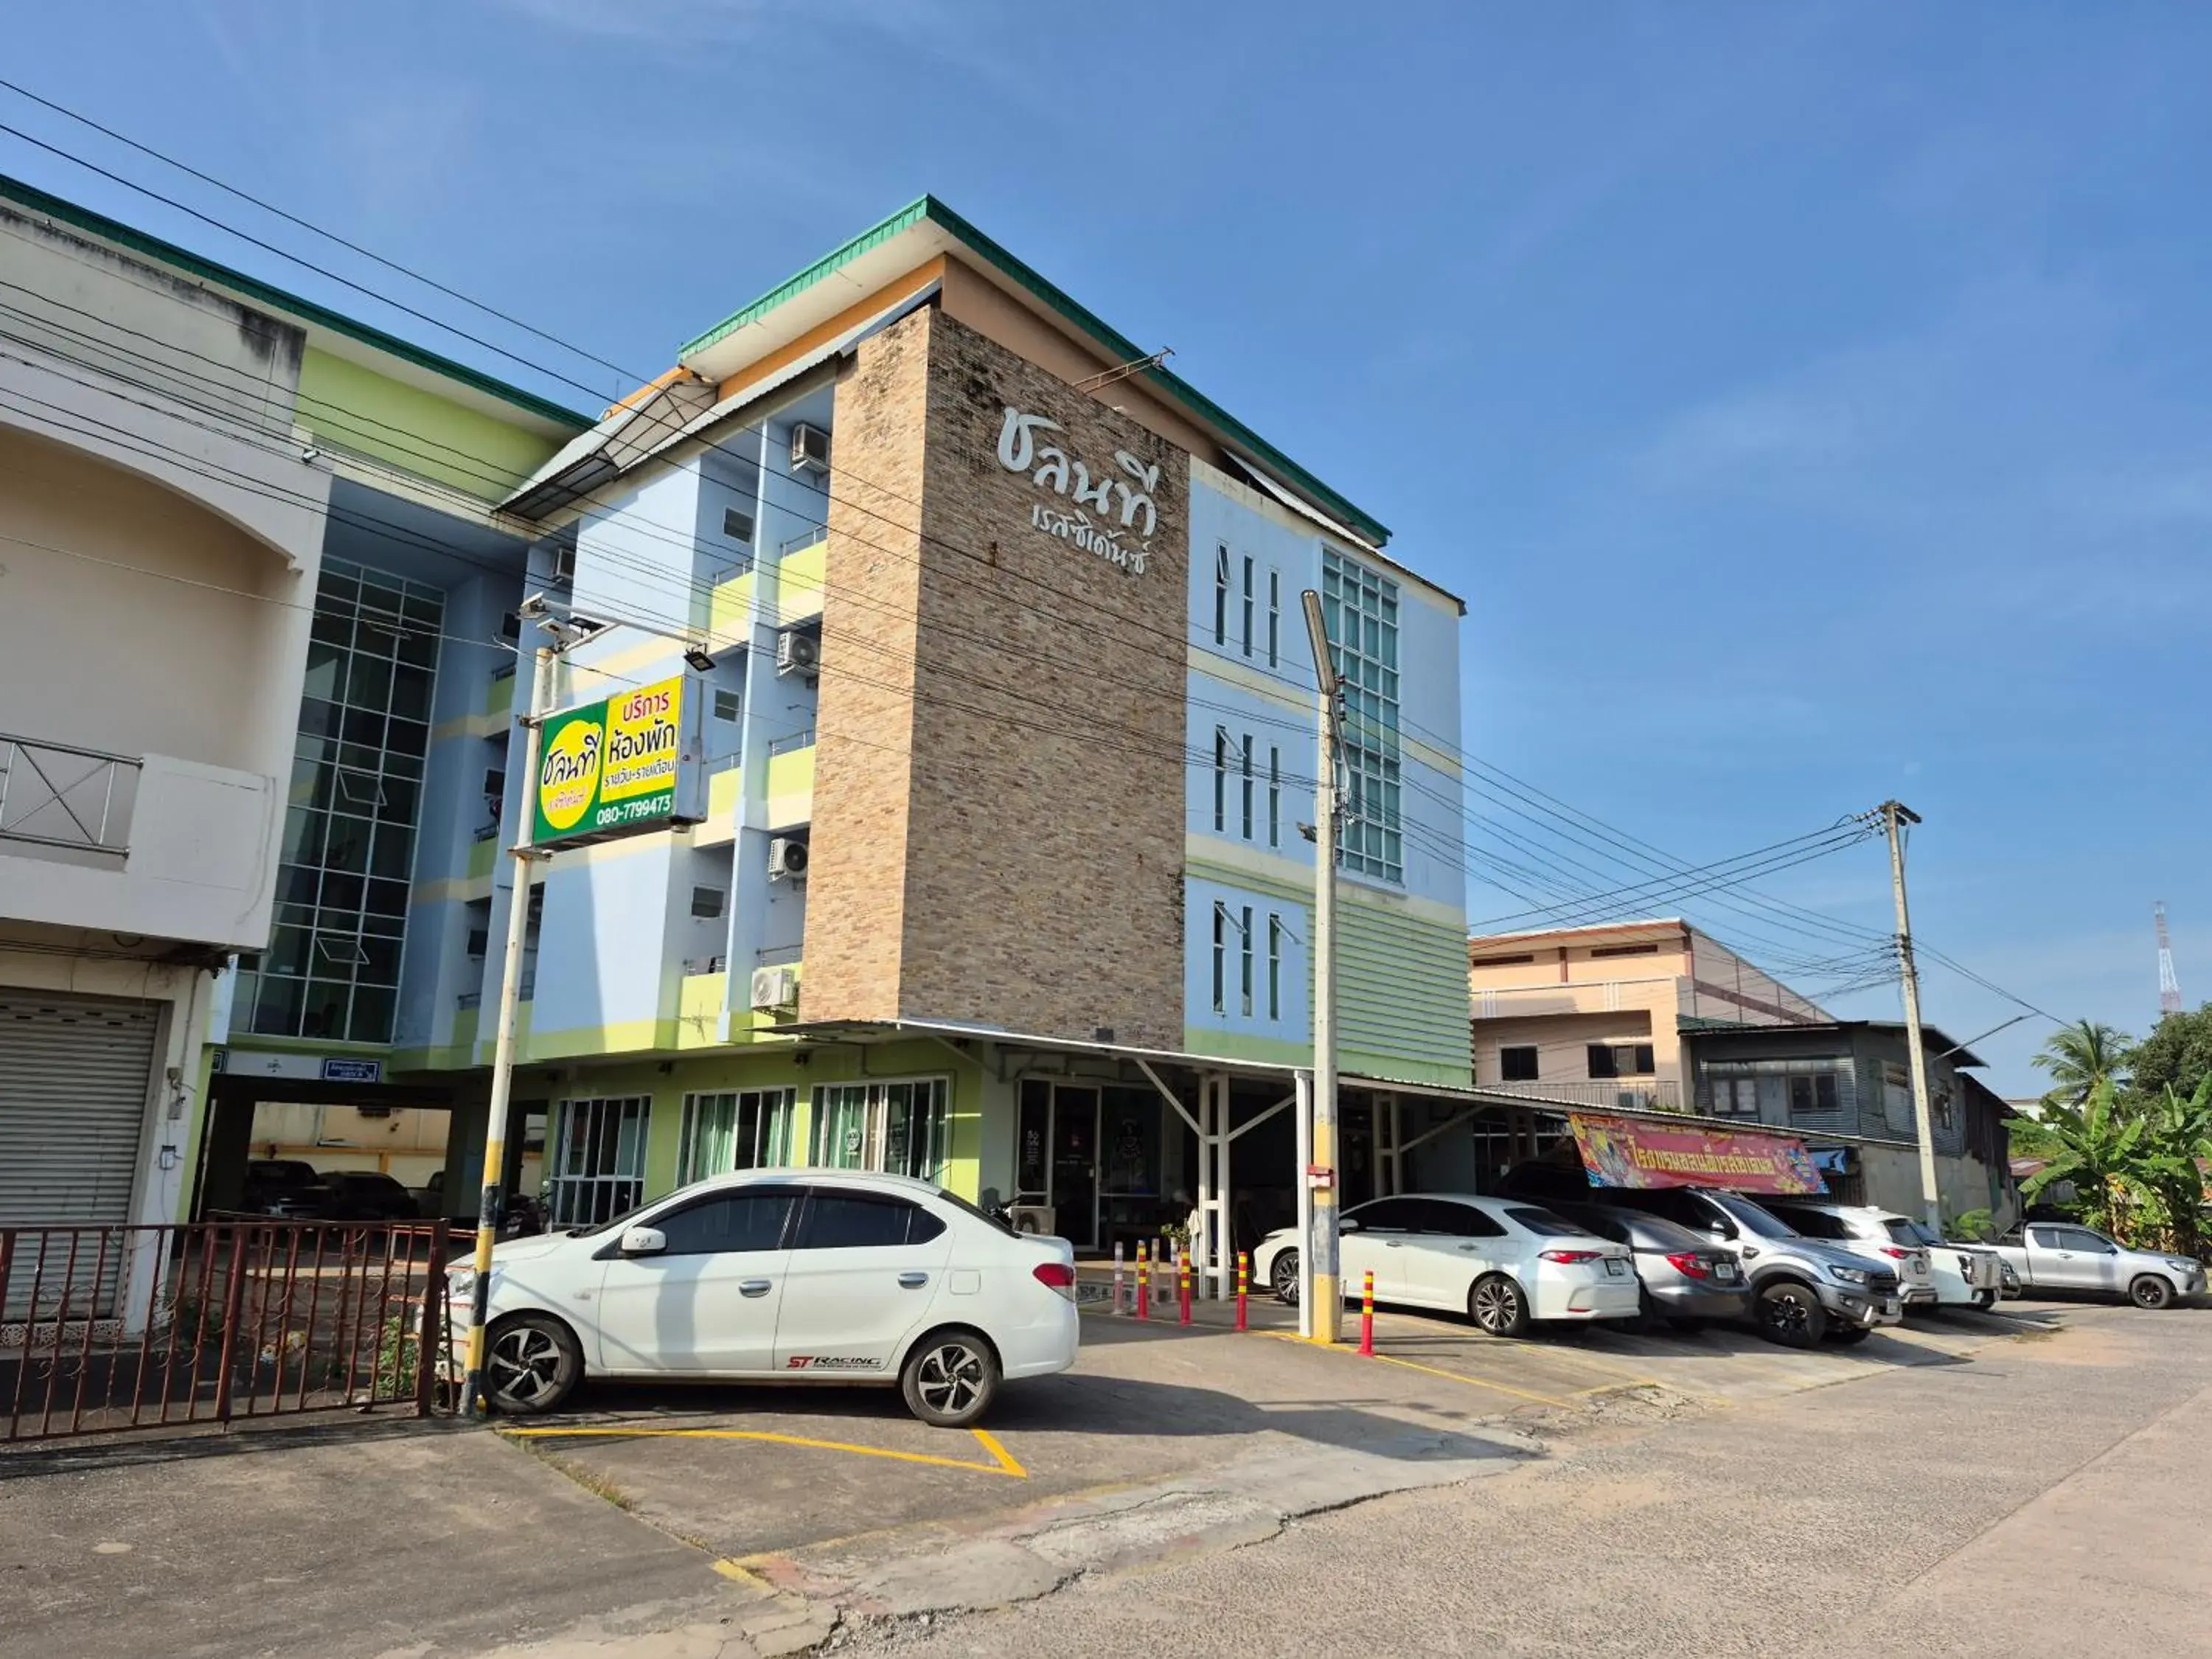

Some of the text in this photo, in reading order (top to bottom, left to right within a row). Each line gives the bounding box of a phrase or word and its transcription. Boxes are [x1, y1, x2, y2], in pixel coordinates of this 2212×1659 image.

[998, 406, 1160, 537] ชลนที
[622, 692, 670, 722] บริการ
[543, 731, 602, 786] ชลนที
[608, 718, 675, 765] ห้องพัก
[597, 794, 671, 825] 080-7799473
[786, 1356, 814, 1368] ST
[813, 1356, 883, 1366] RACING
